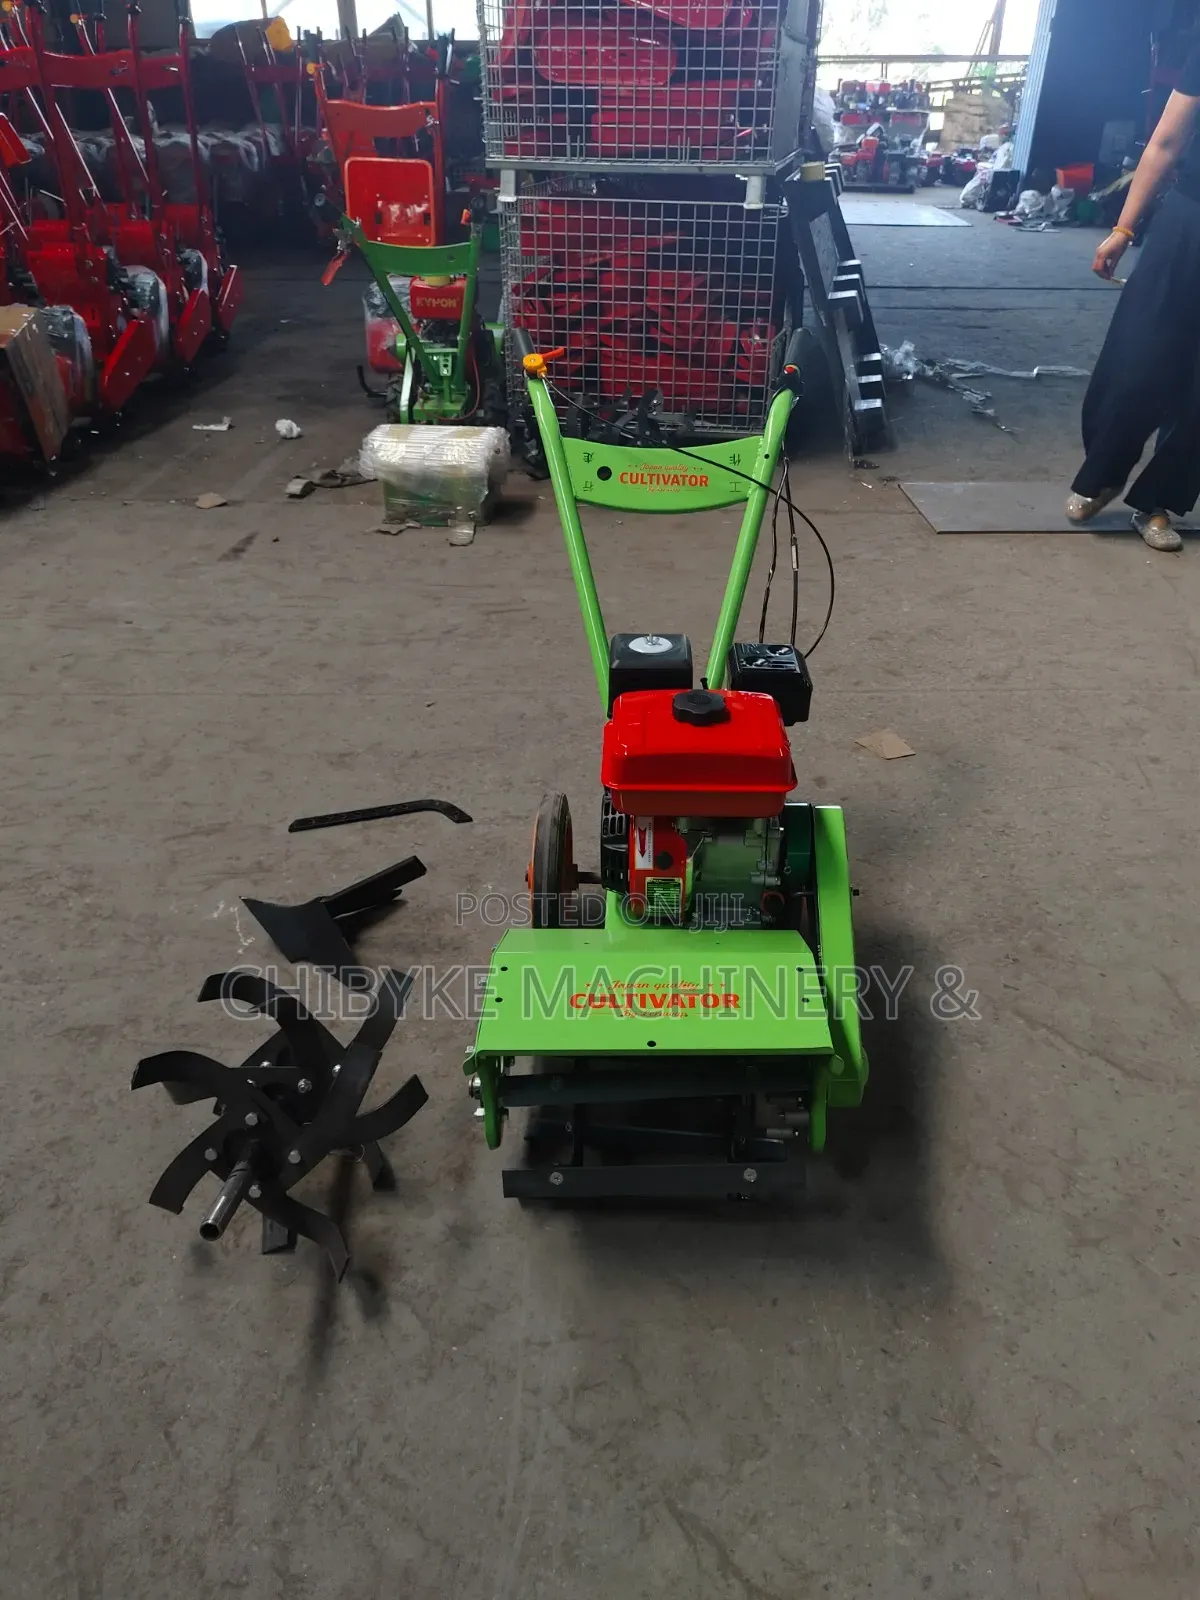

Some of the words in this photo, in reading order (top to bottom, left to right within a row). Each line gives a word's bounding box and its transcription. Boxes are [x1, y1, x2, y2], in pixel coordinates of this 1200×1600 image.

[664, 463, 689, 473] quality
[619, 471, 709, 488] CULTIVATOR
[608, 980, 650, 991] Japan
[653, 980, 700, 991] quality
[569, 993, 742, 1009] CULTIVATOR
